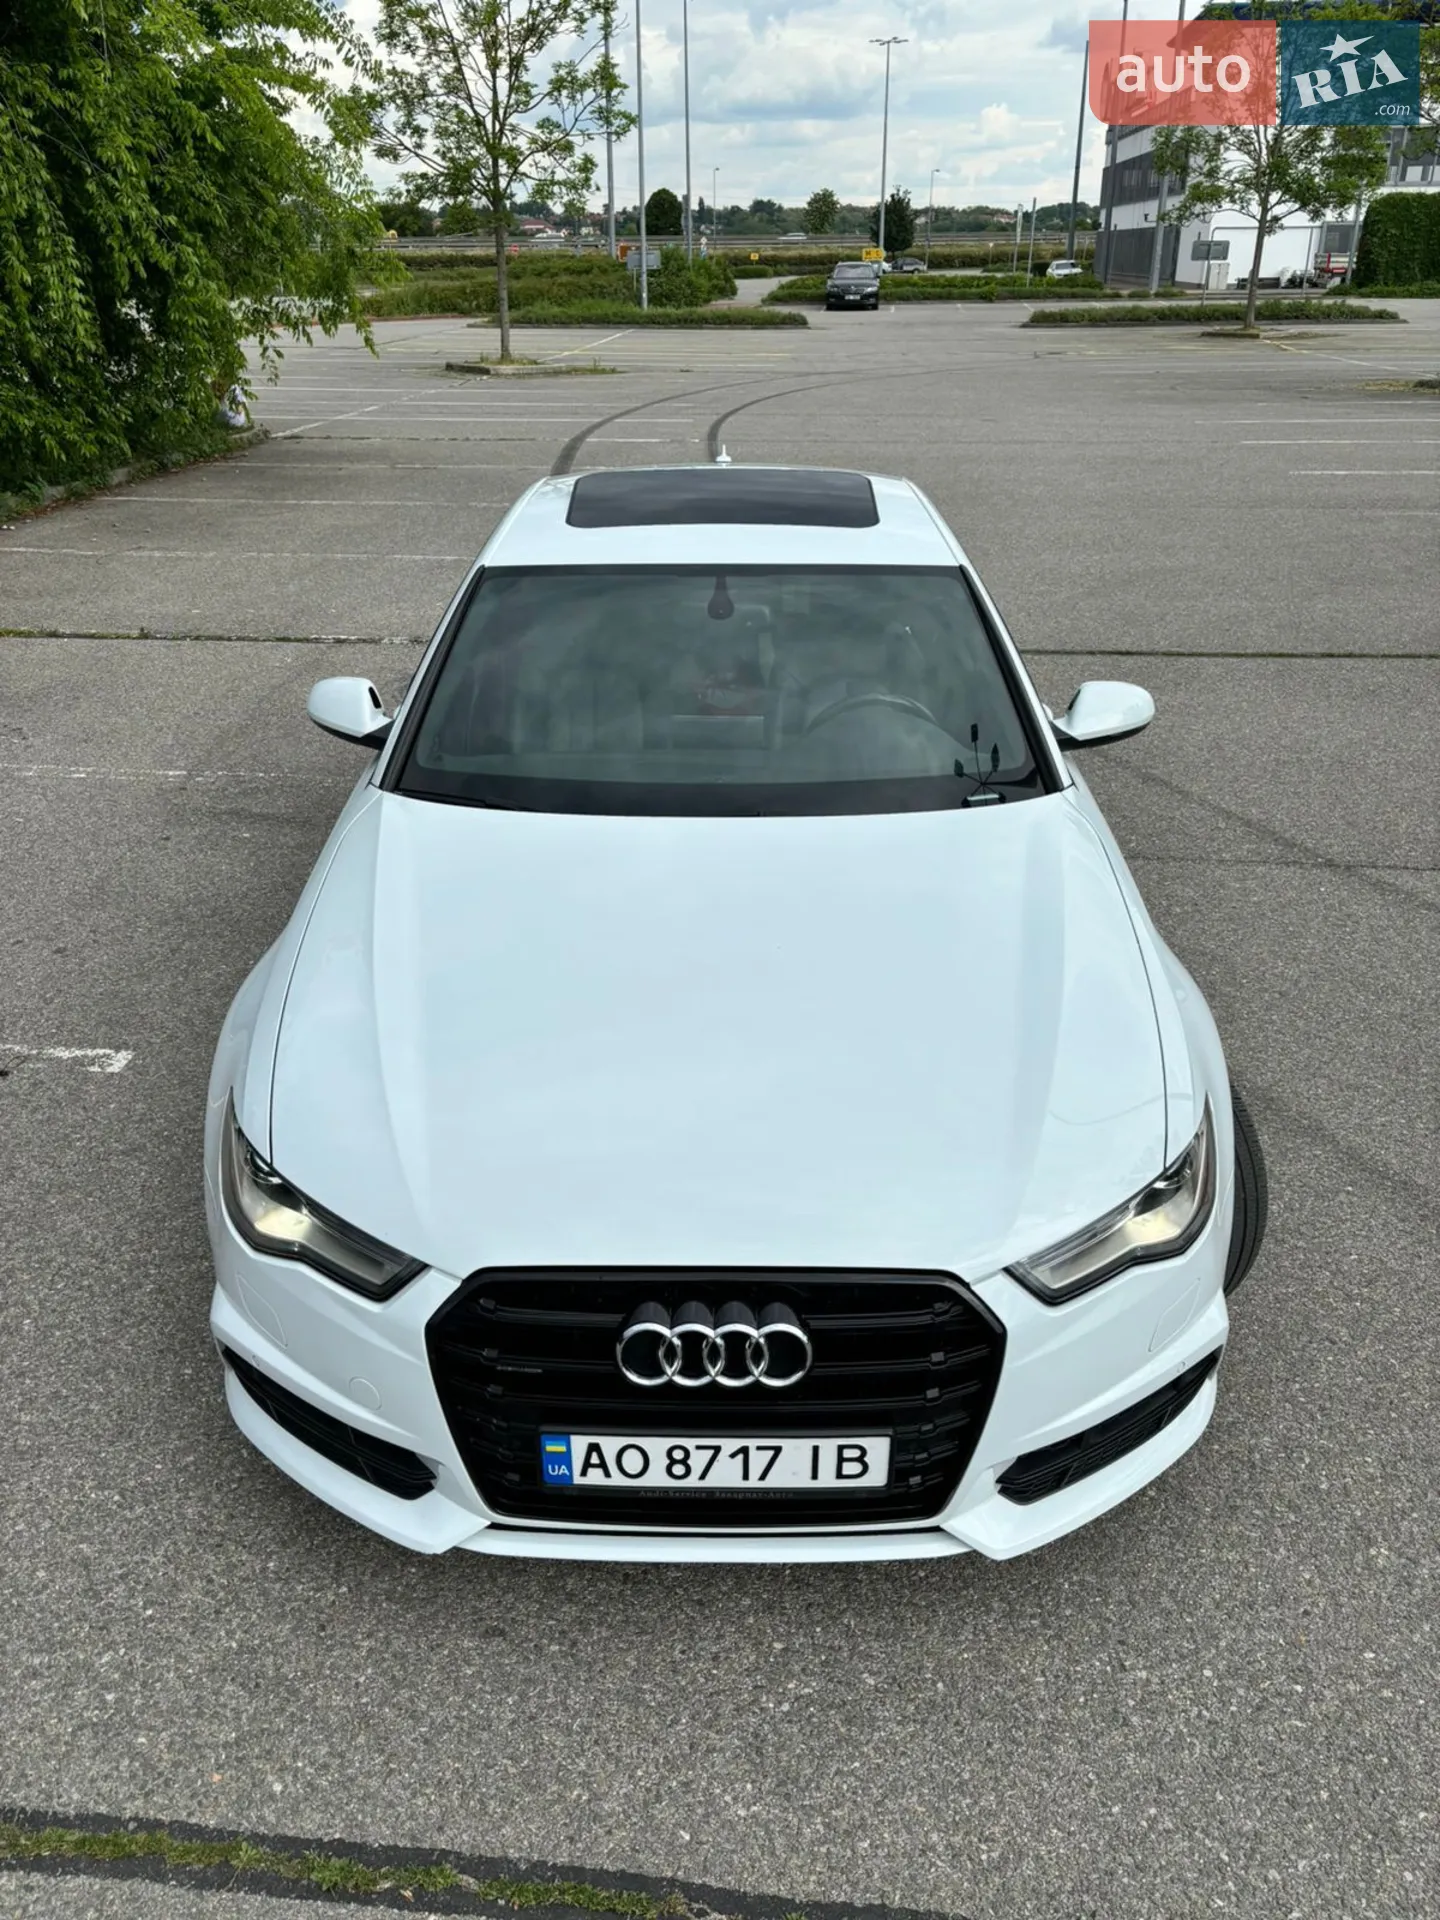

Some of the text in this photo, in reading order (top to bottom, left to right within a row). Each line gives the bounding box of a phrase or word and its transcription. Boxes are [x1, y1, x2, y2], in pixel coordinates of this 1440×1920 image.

[548, 1464, 570, 1476] UA
[579, 1442, 869, 1481] AO 8717 IB
